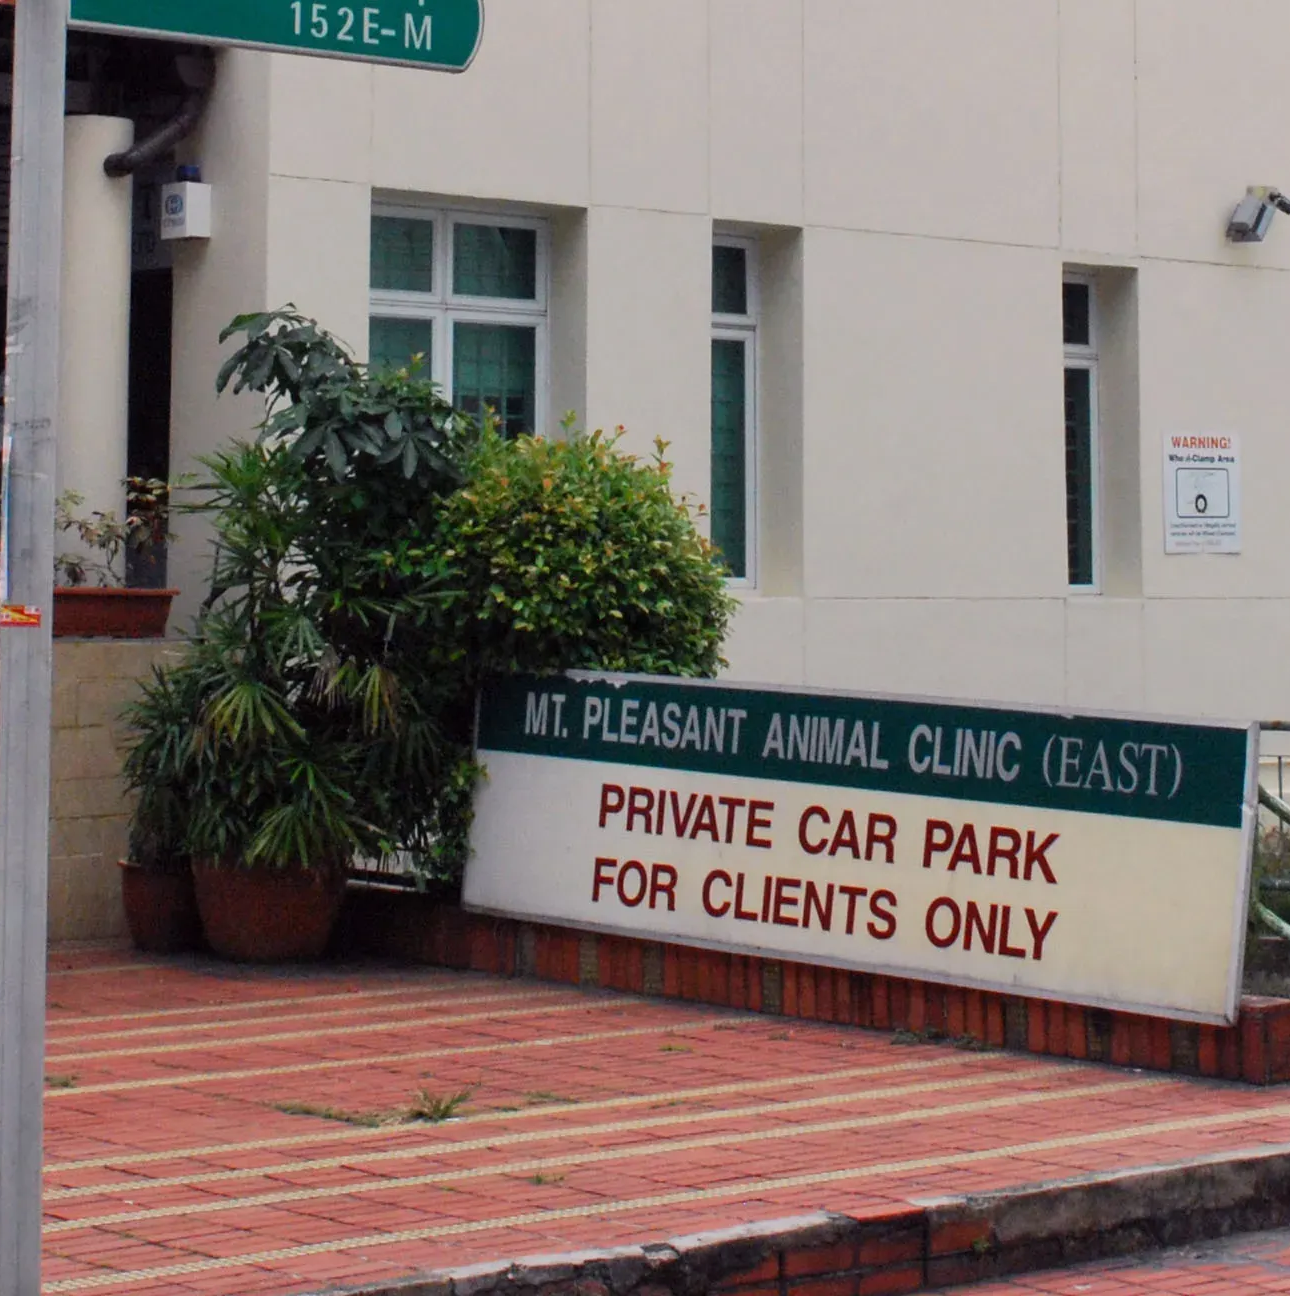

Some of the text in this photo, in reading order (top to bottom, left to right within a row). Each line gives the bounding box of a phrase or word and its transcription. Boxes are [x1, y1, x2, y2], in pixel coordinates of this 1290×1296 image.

[288, 0, 434, 53] 152E-M
[1171, 435, 1232, 449] WARNING!
[524, 691, 1184, 800] MT. PLEASANT ANIMAL CLINIC (EAST)
[597, 782, 1061, 886] PRIVATE CAR PARK
[591, 856, 1060, 962] FOR CLIENTS ONLY
